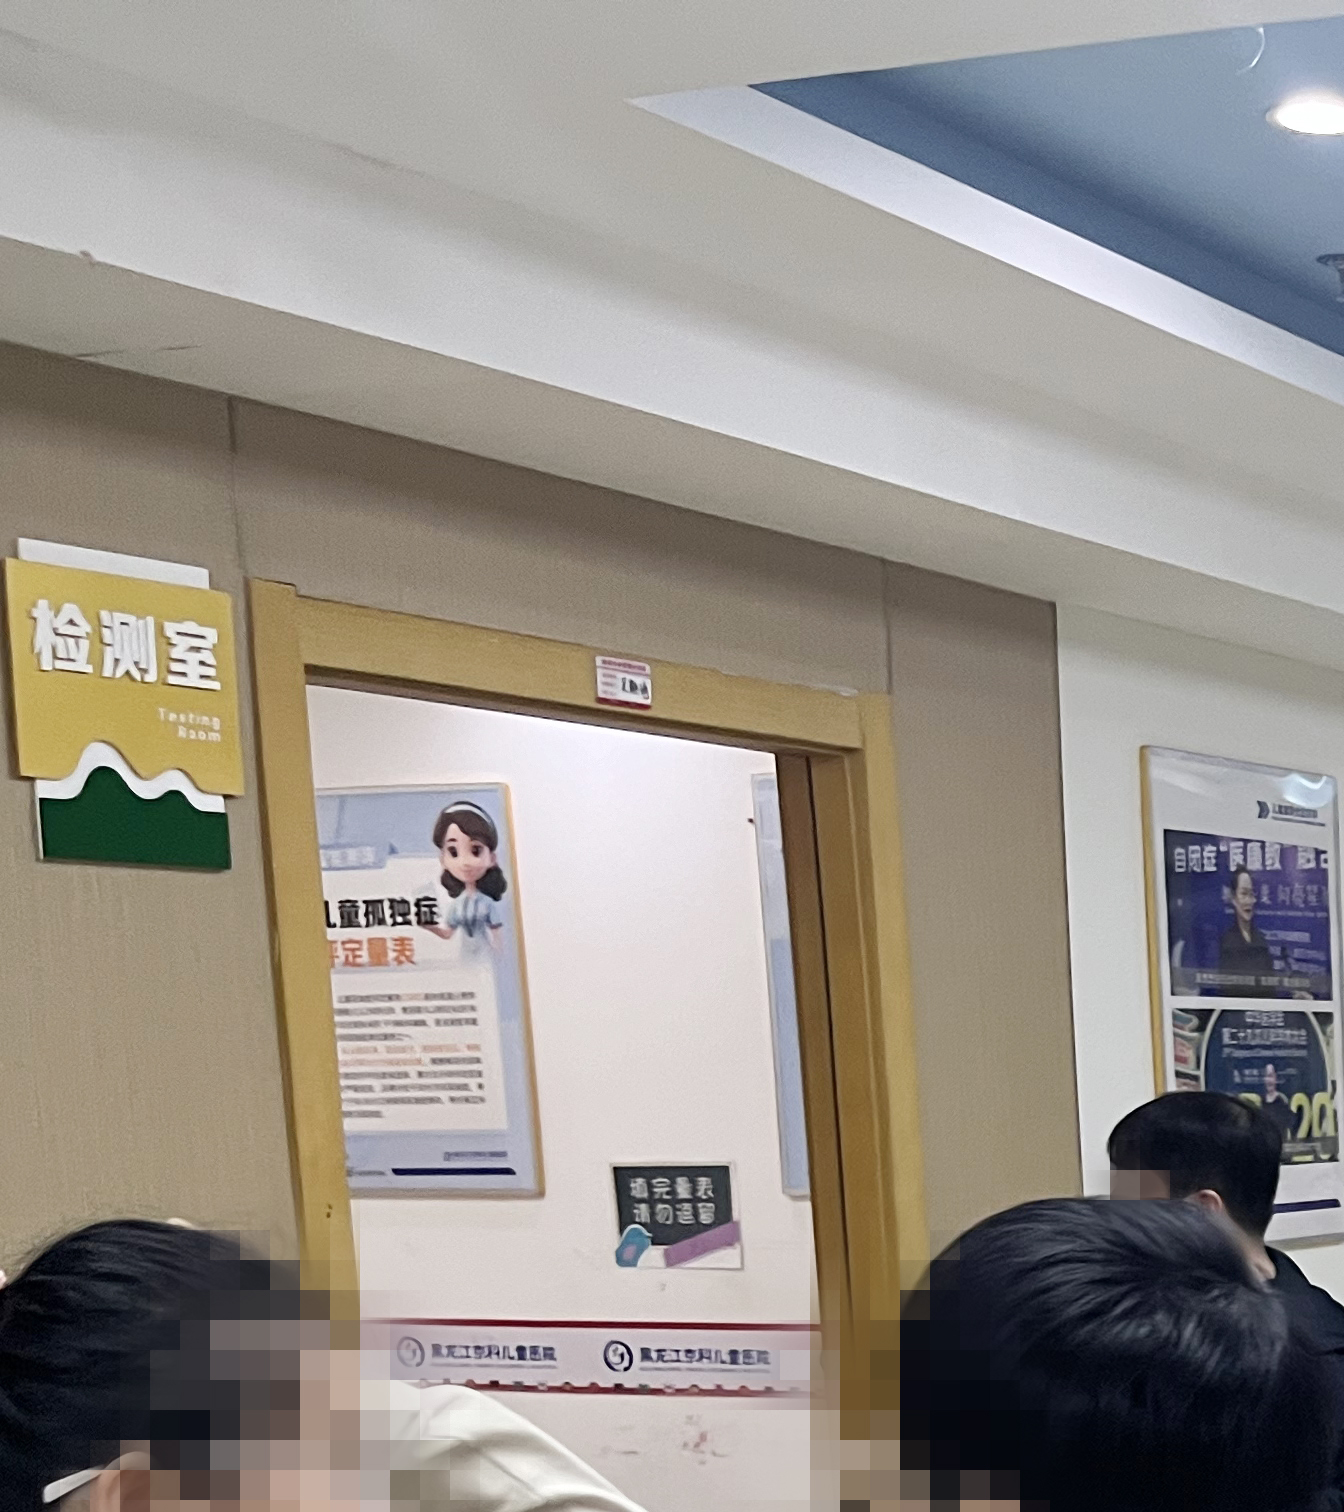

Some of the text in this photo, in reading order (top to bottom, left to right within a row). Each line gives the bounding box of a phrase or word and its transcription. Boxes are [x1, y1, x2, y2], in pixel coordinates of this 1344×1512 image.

[31, 598, 222, 692] 检测室
[158, 707, 221, 731] Testing
